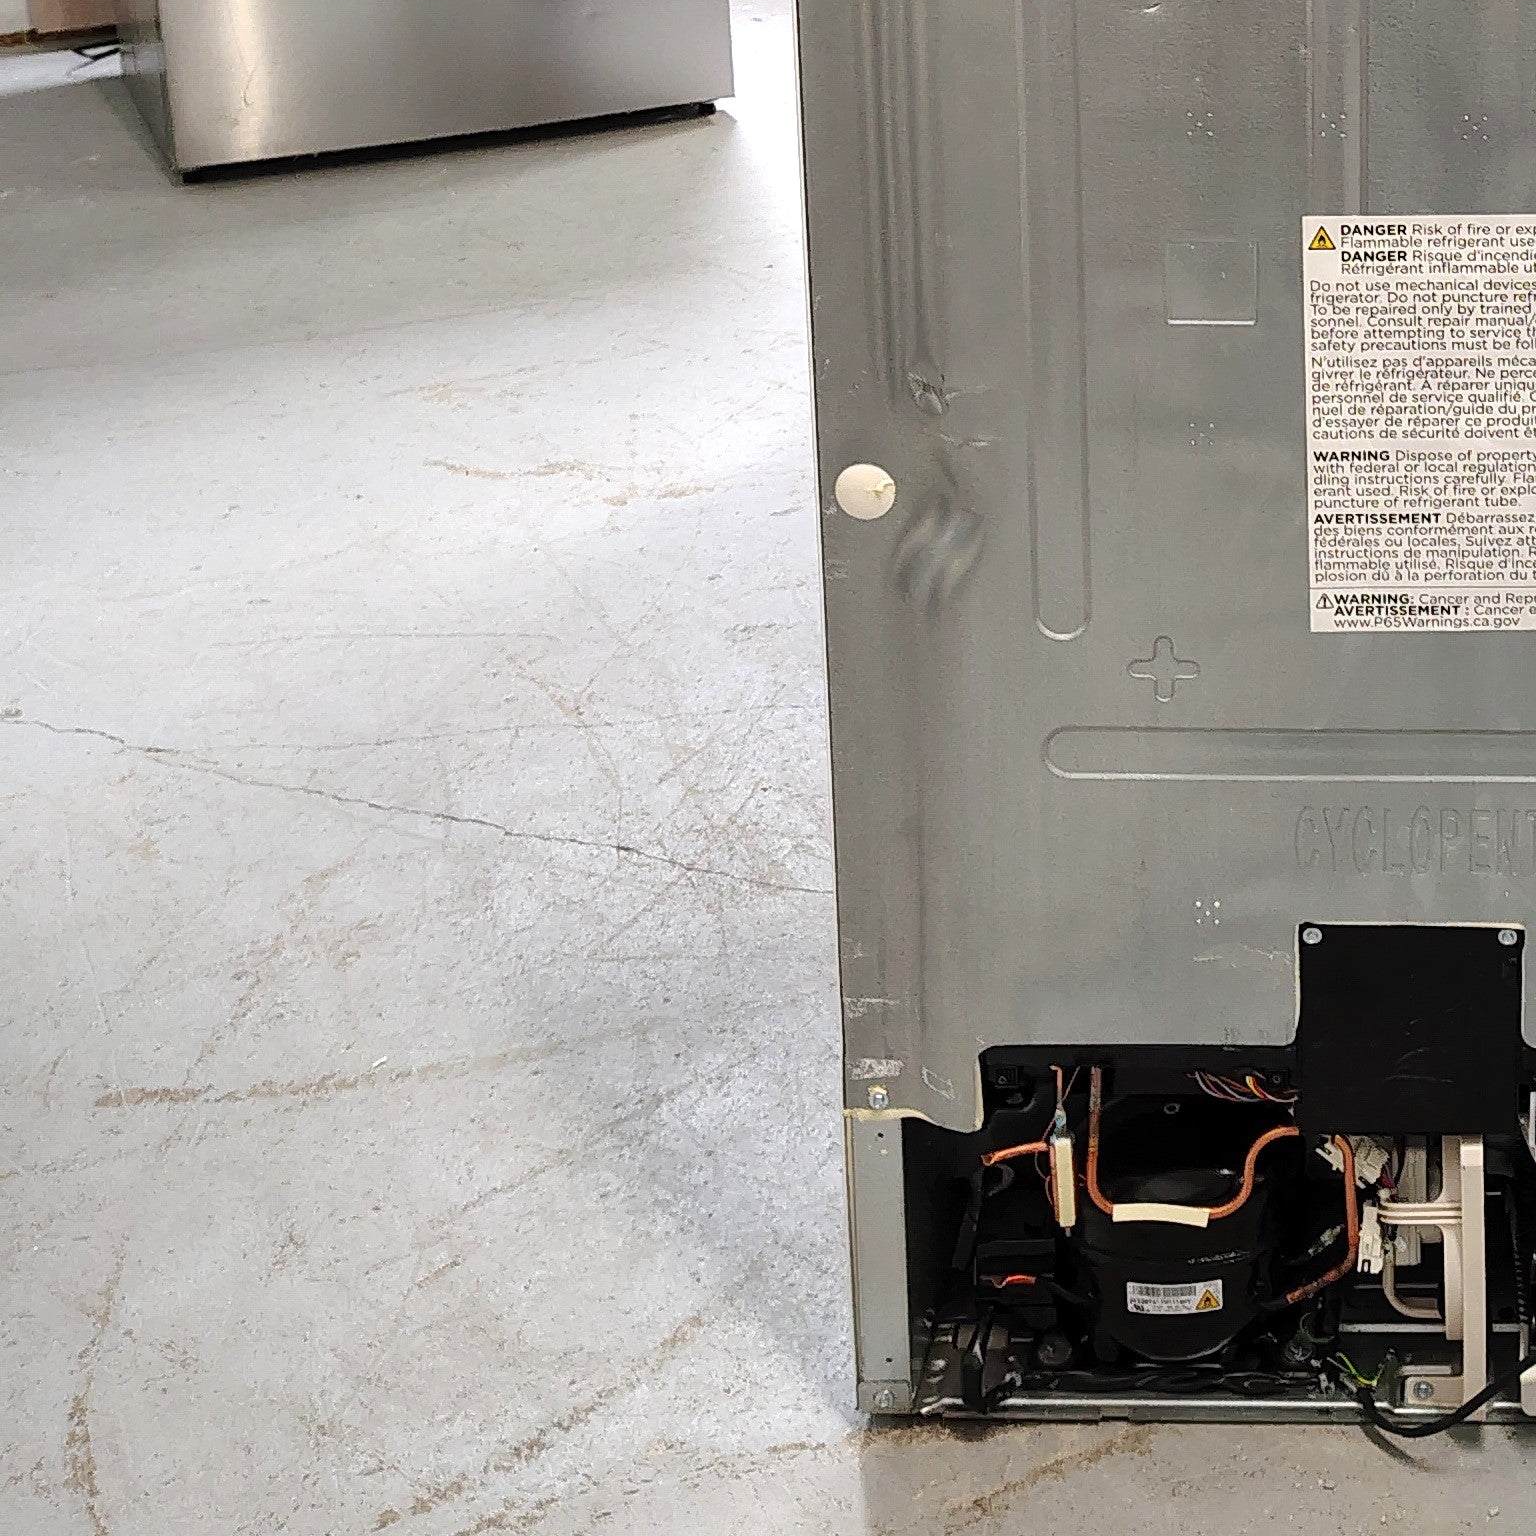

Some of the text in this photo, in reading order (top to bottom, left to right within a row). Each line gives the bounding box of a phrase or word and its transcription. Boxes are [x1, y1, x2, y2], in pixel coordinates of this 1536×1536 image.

[1340, 224, 1407, 236] DANGER
[1412, 224, 1442, 236] Risk
[1447, 224, 1461, 235] of
[1467, 224, 1490, 235] fire
[1495, 226, 1510, 235] or
[1340, 236, 1422, 248] Flammable
[1427, 236, 1504, 250] refrigerant
[1341, 250, 1407, 262] DANGER
[1412, 250, 1462, 264] Risque
[1341, 263, 1423, 277] Réfrigérant
[1310, 280, 1331, 291] Do
[1335, 280, 1359, 291] not
[1365, 282, 1390, 291] use
[1395, 279, 1478, 291] mechanical
[1312, 304, 1327, 315] To
[1332, 303, 1351, 315] be
[1355, 303, 1417, 317] repaired
[1421, 303, 1452, 317] only
[1457, 303, 1475, 317] by
[1480, 303, 1532, 314] trained
[1311, 327, 1358, 339] before
[1363, 327, 1445, 341] attempting
[1449, 327, 1465, 338] to
[1469, 327, 1521, 338] service
[1311, 339, 1355, 353] safety
[1360, 339, 1447, 353] precautions
[1451, 338, 1488, 350] must
[1492, 338, 1511, 350] be
[1311, 356, 1377, 368] N'utilisez
[1382, 358, 1407, 370] pas
[1412, 355, 1492, 369] d'appareils
[1311, 368, 1354, 382] givrer
[1359, 368, 1371, 380] le
[1475, 367, 1495, 379] Ne
[1312, 403, 1342, 415] nuel
[1347, 403, 1365, 414] de
[1370, 403, 1493, 417] réparation/guide
[1497, 402, 1516, 414] du
[1312, 427, 1374, 439] cautions
[1379, 427, 1397, 439] de
[1464, 427, 1519, 438] doivent
[1313, 450, 1390, 461] WARNING
[1395, 450, 1452, 464] Dispose
[1457, 449, 1471, 461] of
[1313, 462, 1344, 473] with
[1349, 461, 1399, 473] federal
[1403, 464, 1419, 473] or
[1424, 461, 1458, 473] local
[1313, 473, 1349, 487] dling
[1354, 473, 1439, 484] instructions
[1314, 497, 1379, 511] puncture
[1383, 496, 1398, 508] of
[1403, 496, 1479, 510] refrigerant
[1314, 512, 1441, 524] AVERTISSEMENT
[1313, 524, 1339, 536] des
[1343, 524, 1382, 535] biens
[1386, 523, 1493, 535] conformément
[1498, 526, 1524, 534] aux
[1314, 558, 1390, 570] flammable
[1445, 557, 1494, 571] Risque
[1333, 592, 1414, 604] WARNING:
[1418, 592, 1469, 604] Cancer
[1473, 592, 1500, 603] and
[1333, 604, 1460, 615] AVERTISSEMENT
[1473, 604, 1524, 615] Cancer
[1333, 615, 1520, 629] www.P65Warnings.ca.gov
